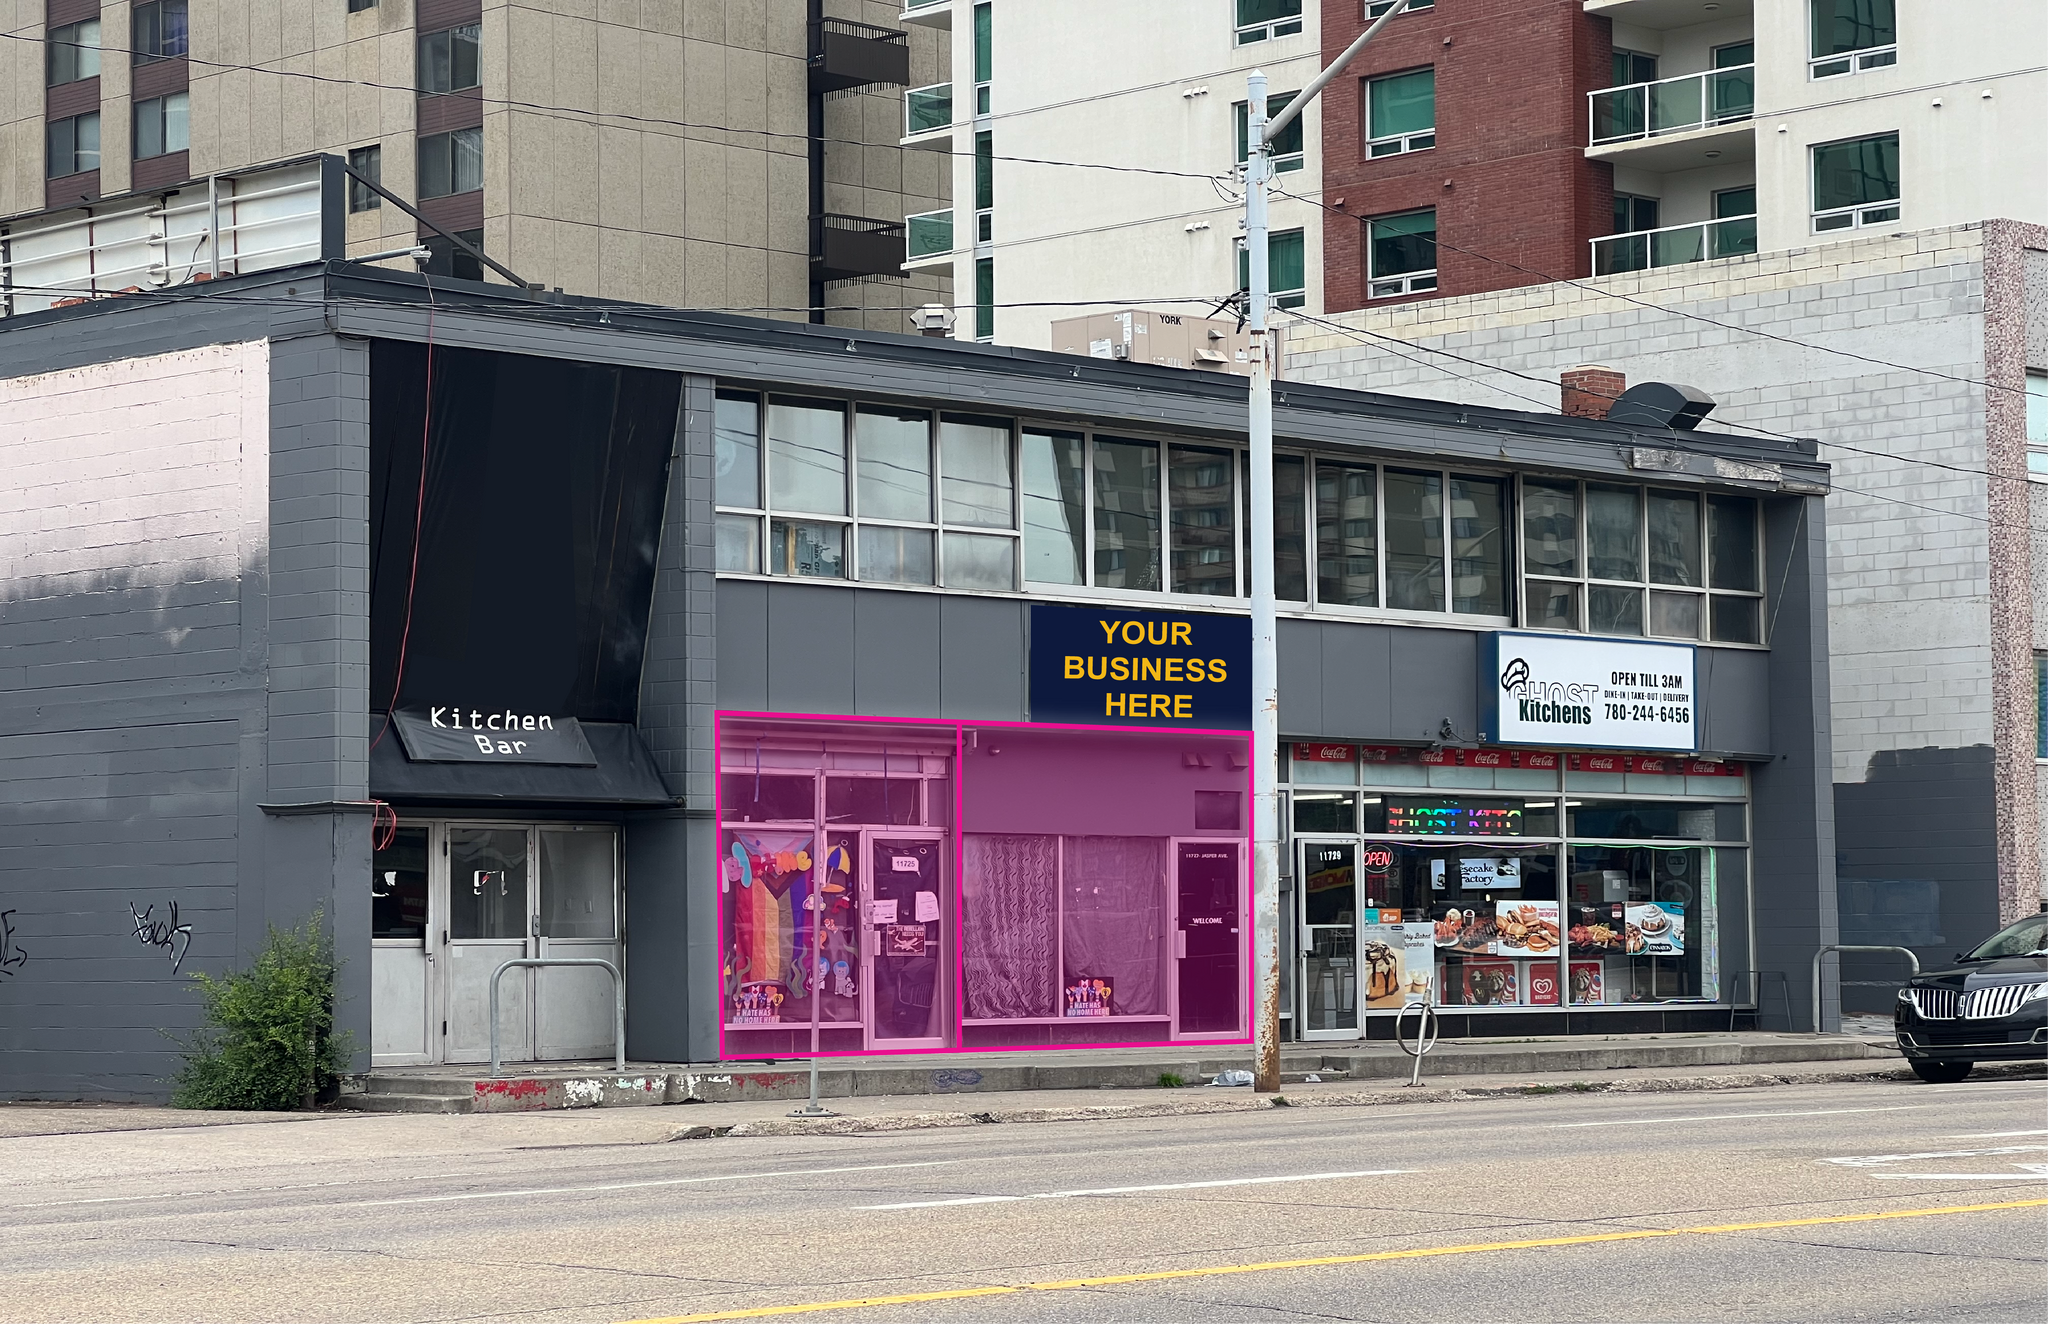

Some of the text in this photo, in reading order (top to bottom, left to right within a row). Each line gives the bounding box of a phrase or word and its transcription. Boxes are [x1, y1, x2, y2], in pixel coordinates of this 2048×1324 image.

[1159, 314, 1182, 326] YORK
[1611, 671, 1683, 689] OPEN TILL 3AM
[1508, 681, 1600, 704] GHOST
[1604, 690, 1689, 703] DINE-IN TAKE-OUT DELIVERY
[1519, 698, 1592, 725] Kitchens
[1604, 703, 1690, 724] 780-244-6456
[430, 706, 554, 731] Kitchen
[473, 734, 527, 755] Bar
[1319, 850, 1342, 862] 11729
[1363, 851, 1391, 866] OPEN
[896, 860, 916, 868] 11725
[1192, 917, 1223, 925] WELCOME
[1074, 1001, 1101, 1009] HATE HAS
[742, 1008, 771, 1017] HATE HAS
[1067, 1008, 1076, 1016] NO
[1076, 1008, 1094, 1016] HOME
[733, 1016, 743, 1024] NO
[744, 1016, 763, 1024] HOME
